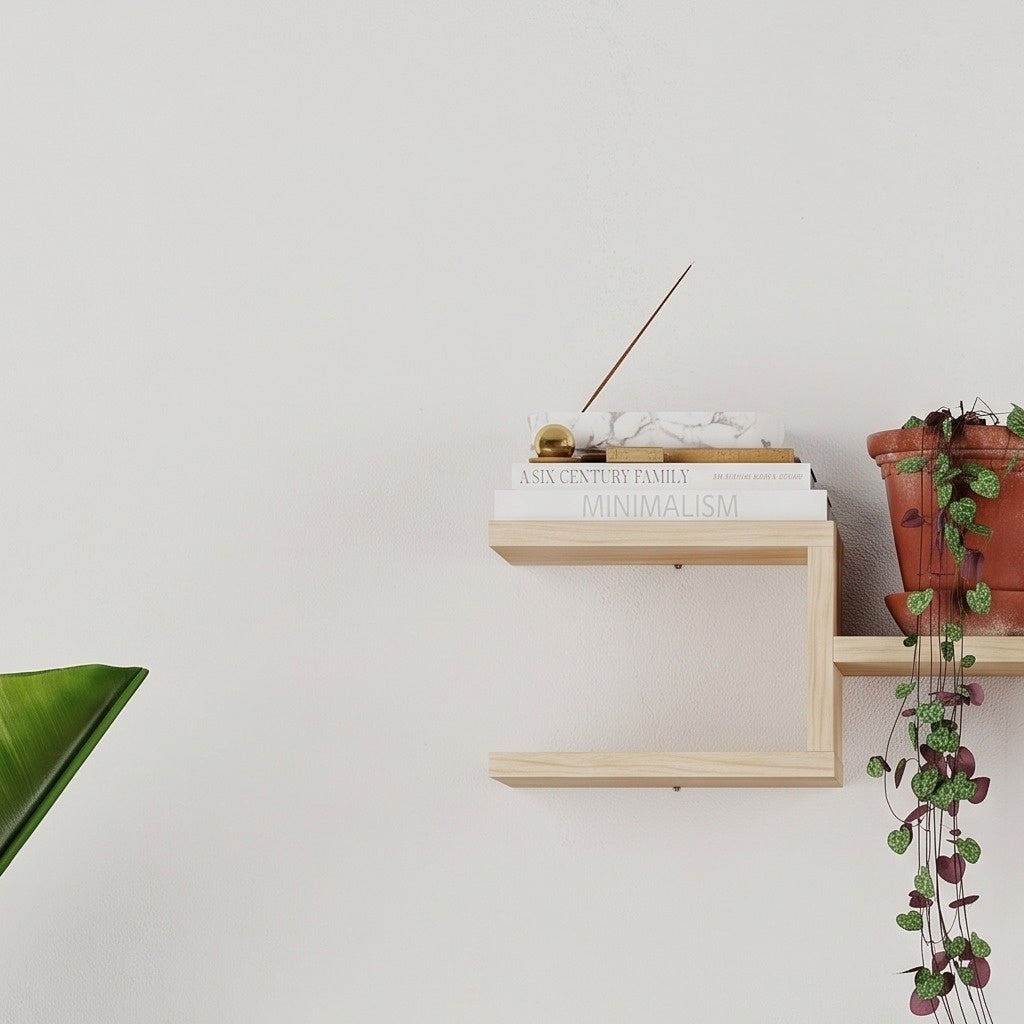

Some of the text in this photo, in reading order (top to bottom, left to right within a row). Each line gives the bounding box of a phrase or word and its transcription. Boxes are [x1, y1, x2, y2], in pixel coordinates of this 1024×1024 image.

[559, 469, 630, 484] CENTURY
[634, 469, 690, 484] FAMILY
[582, 494, 739, 518] MINIMALISM
